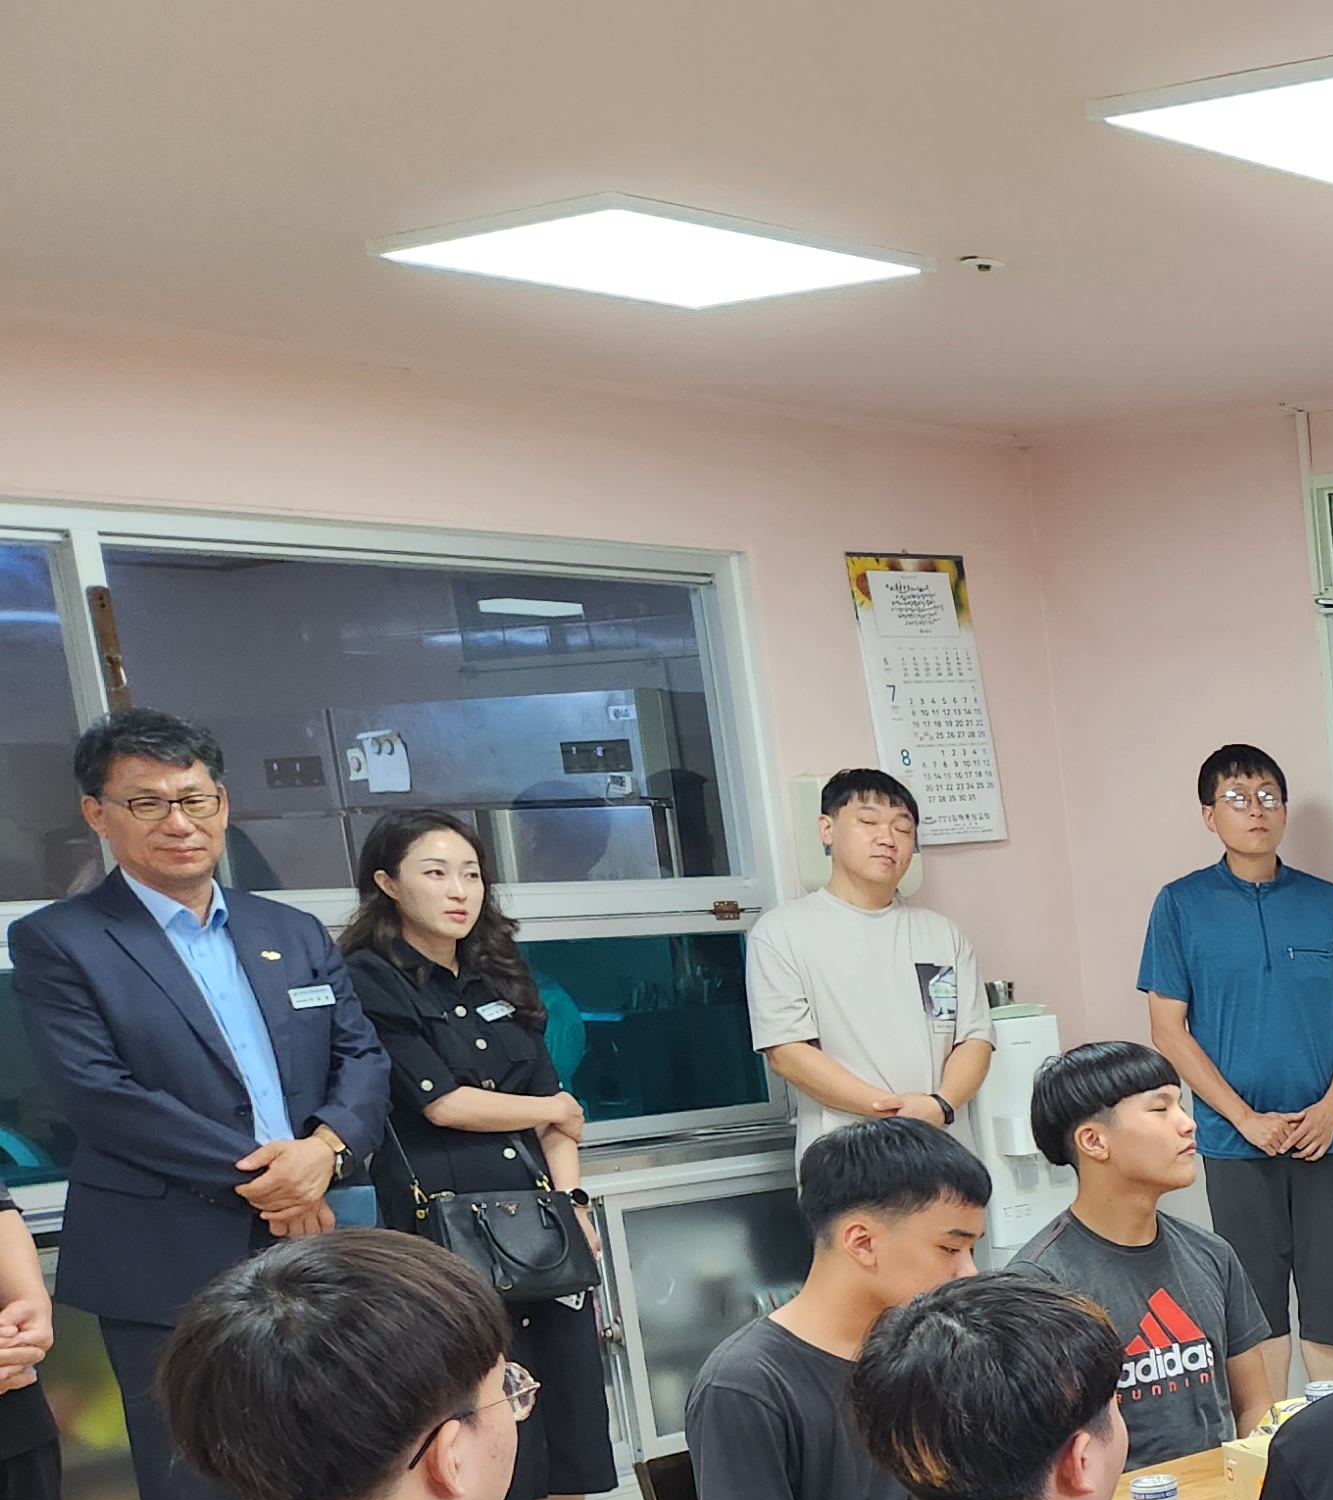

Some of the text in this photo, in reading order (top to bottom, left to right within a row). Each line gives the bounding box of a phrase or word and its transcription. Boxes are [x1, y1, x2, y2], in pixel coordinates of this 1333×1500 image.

[886, 685, 896, 702] 7
[901, 749, 912, 766] 8
[1116, 1341, 1215, 1389] adidas
